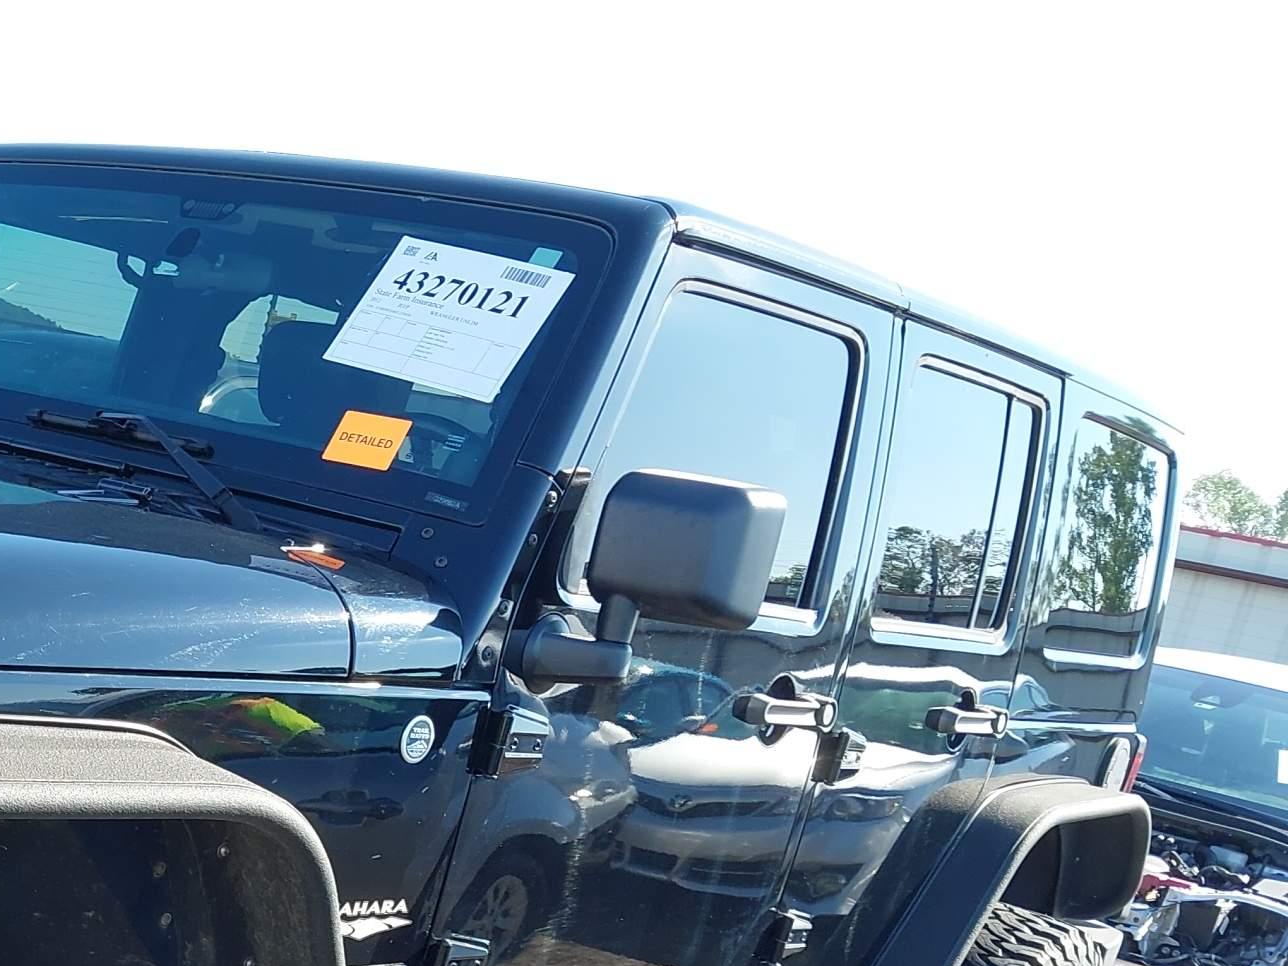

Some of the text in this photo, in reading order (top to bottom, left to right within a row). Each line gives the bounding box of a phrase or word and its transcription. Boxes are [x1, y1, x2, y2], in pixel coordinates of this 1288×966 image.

[374, 287, 393, 299] State
[392, 291, 411, 302] Farm
[393, 268, 530, 318] 43270121
[338, 431, 394, 449] DETAILED
[339, 898, 409, 917] AHARA
